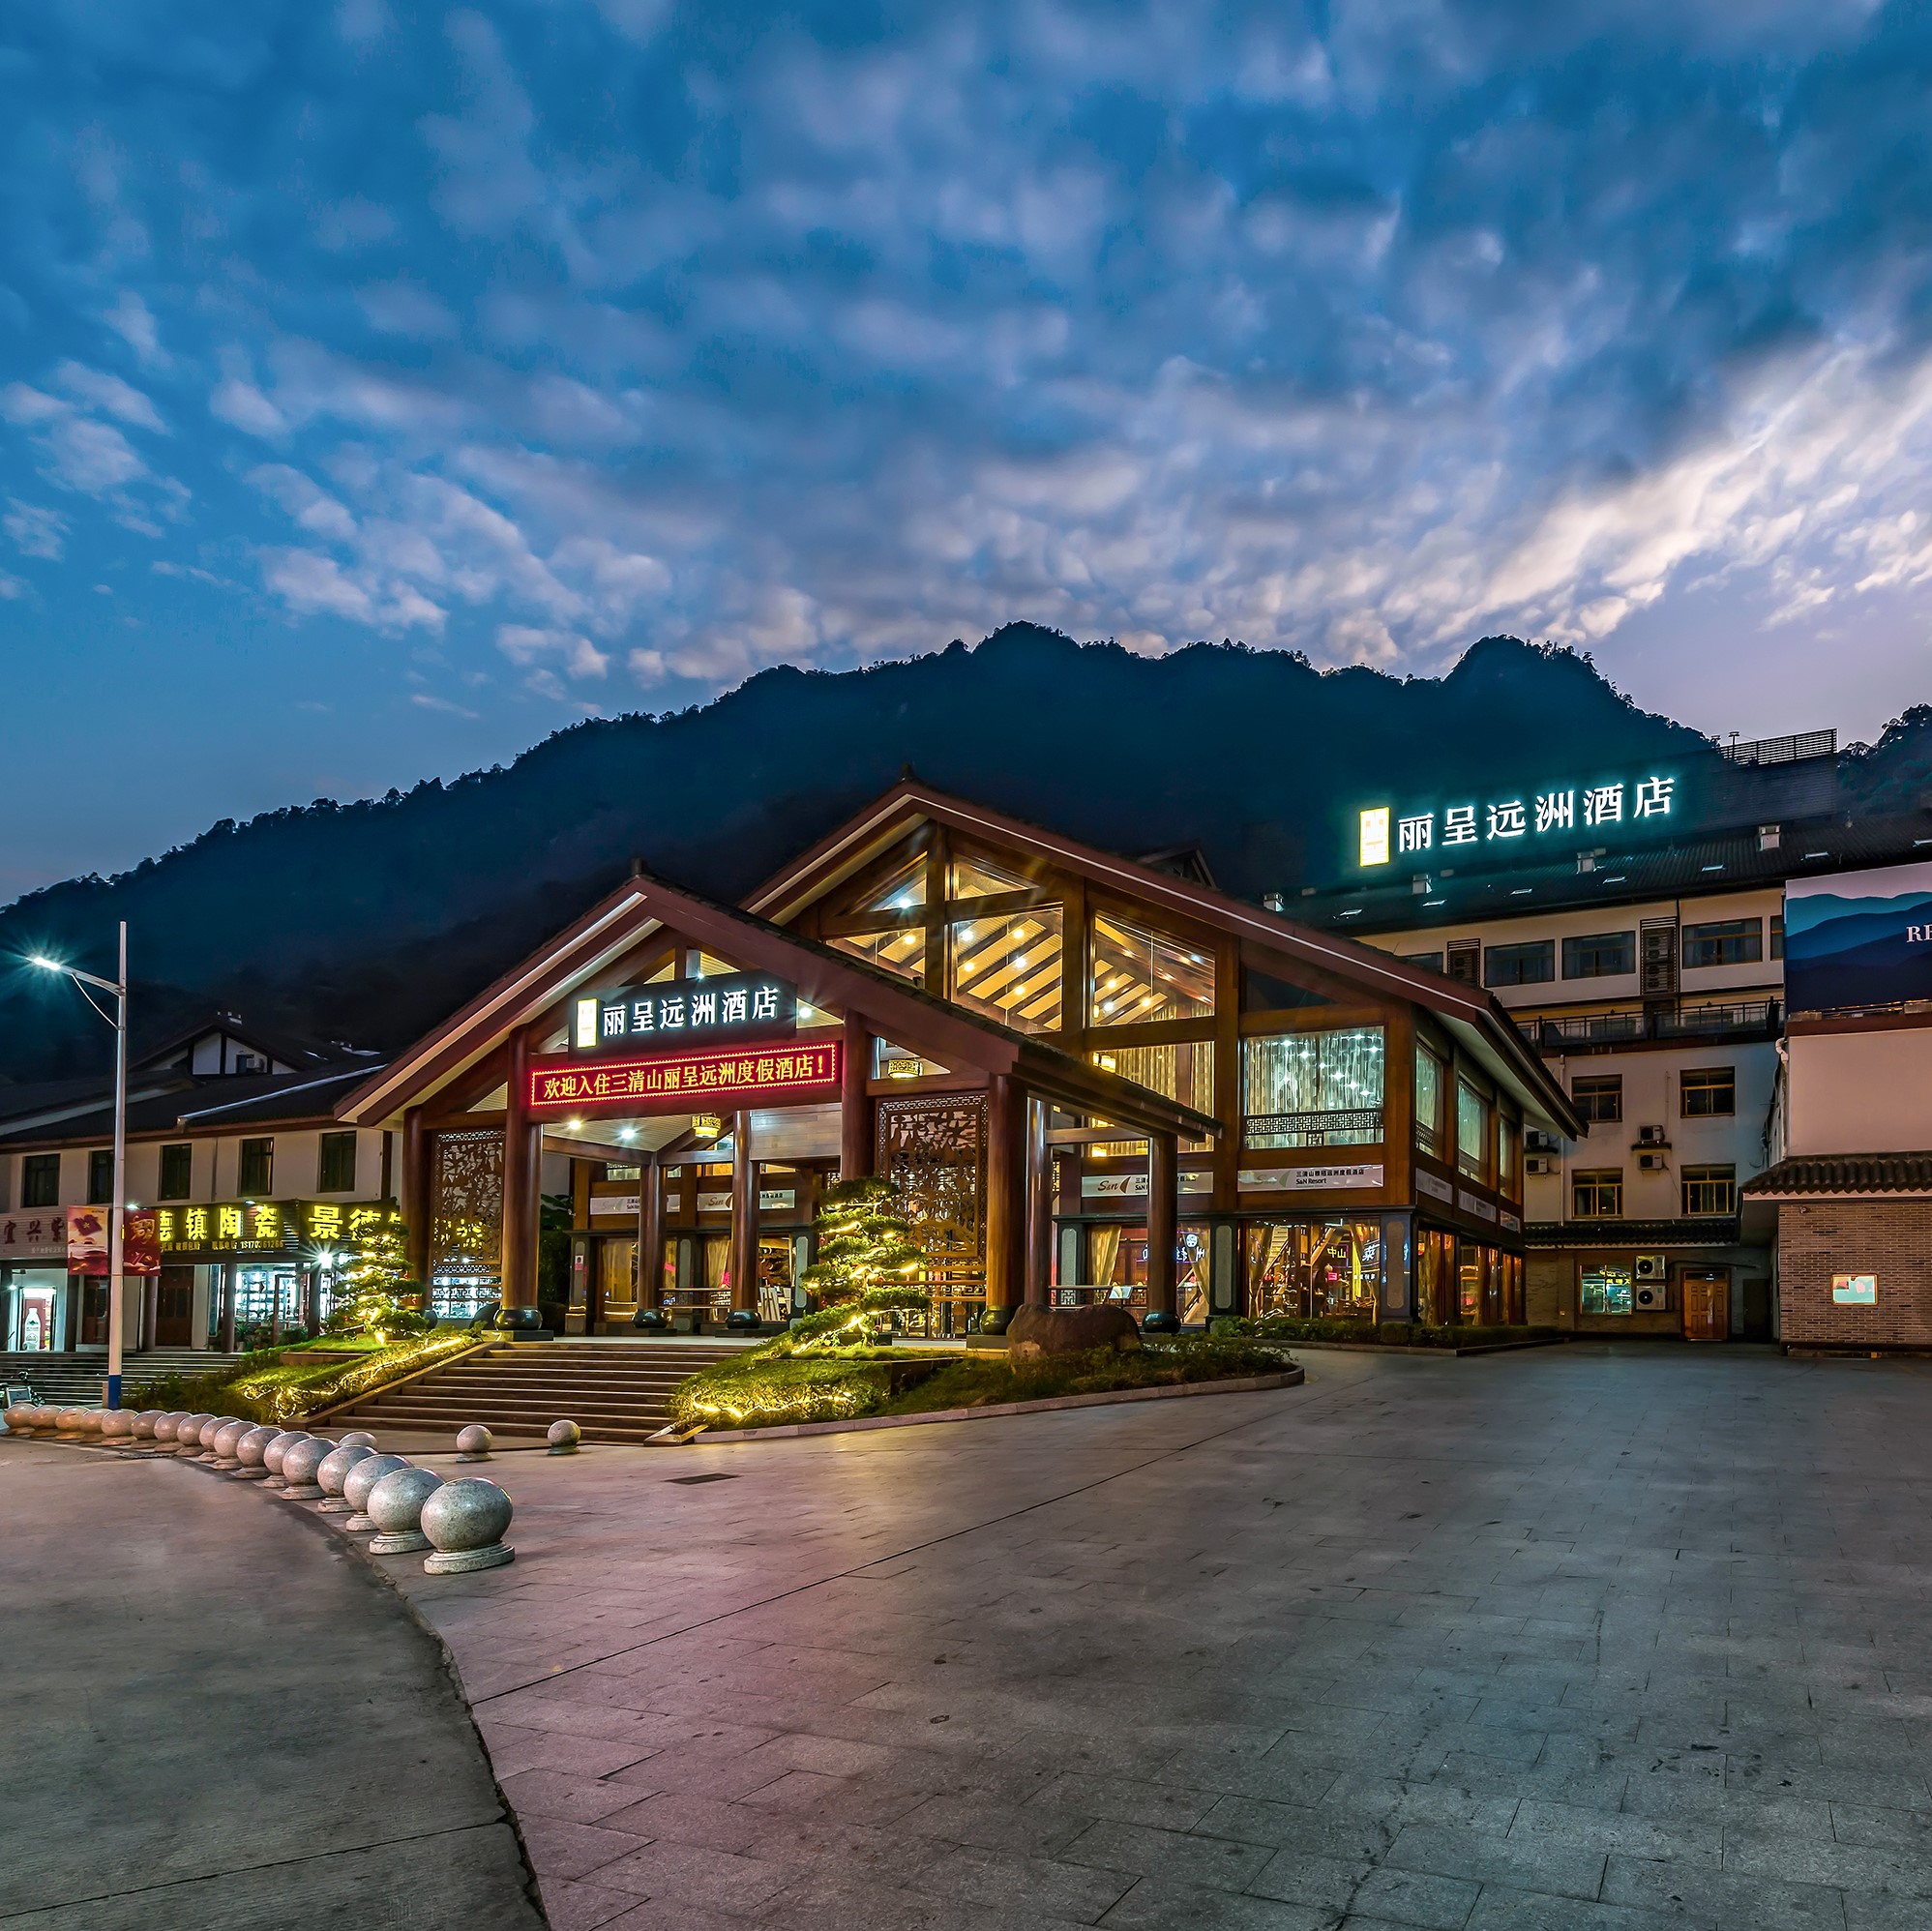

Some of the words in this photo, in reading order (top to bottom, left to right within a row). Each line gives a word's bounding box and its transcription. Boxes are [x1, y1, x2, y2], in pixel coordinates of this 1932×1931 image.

[1398, 776, 1675, 852] 丽呈远洲酒店
[1906, 925, 1932, 942] RE
[603, 986, 779, 1036] 丽呈远洲酒店
[122, 1205, 278, 1241] 德镇陶瓷
[308, 1204, 401, 1241] 景德
